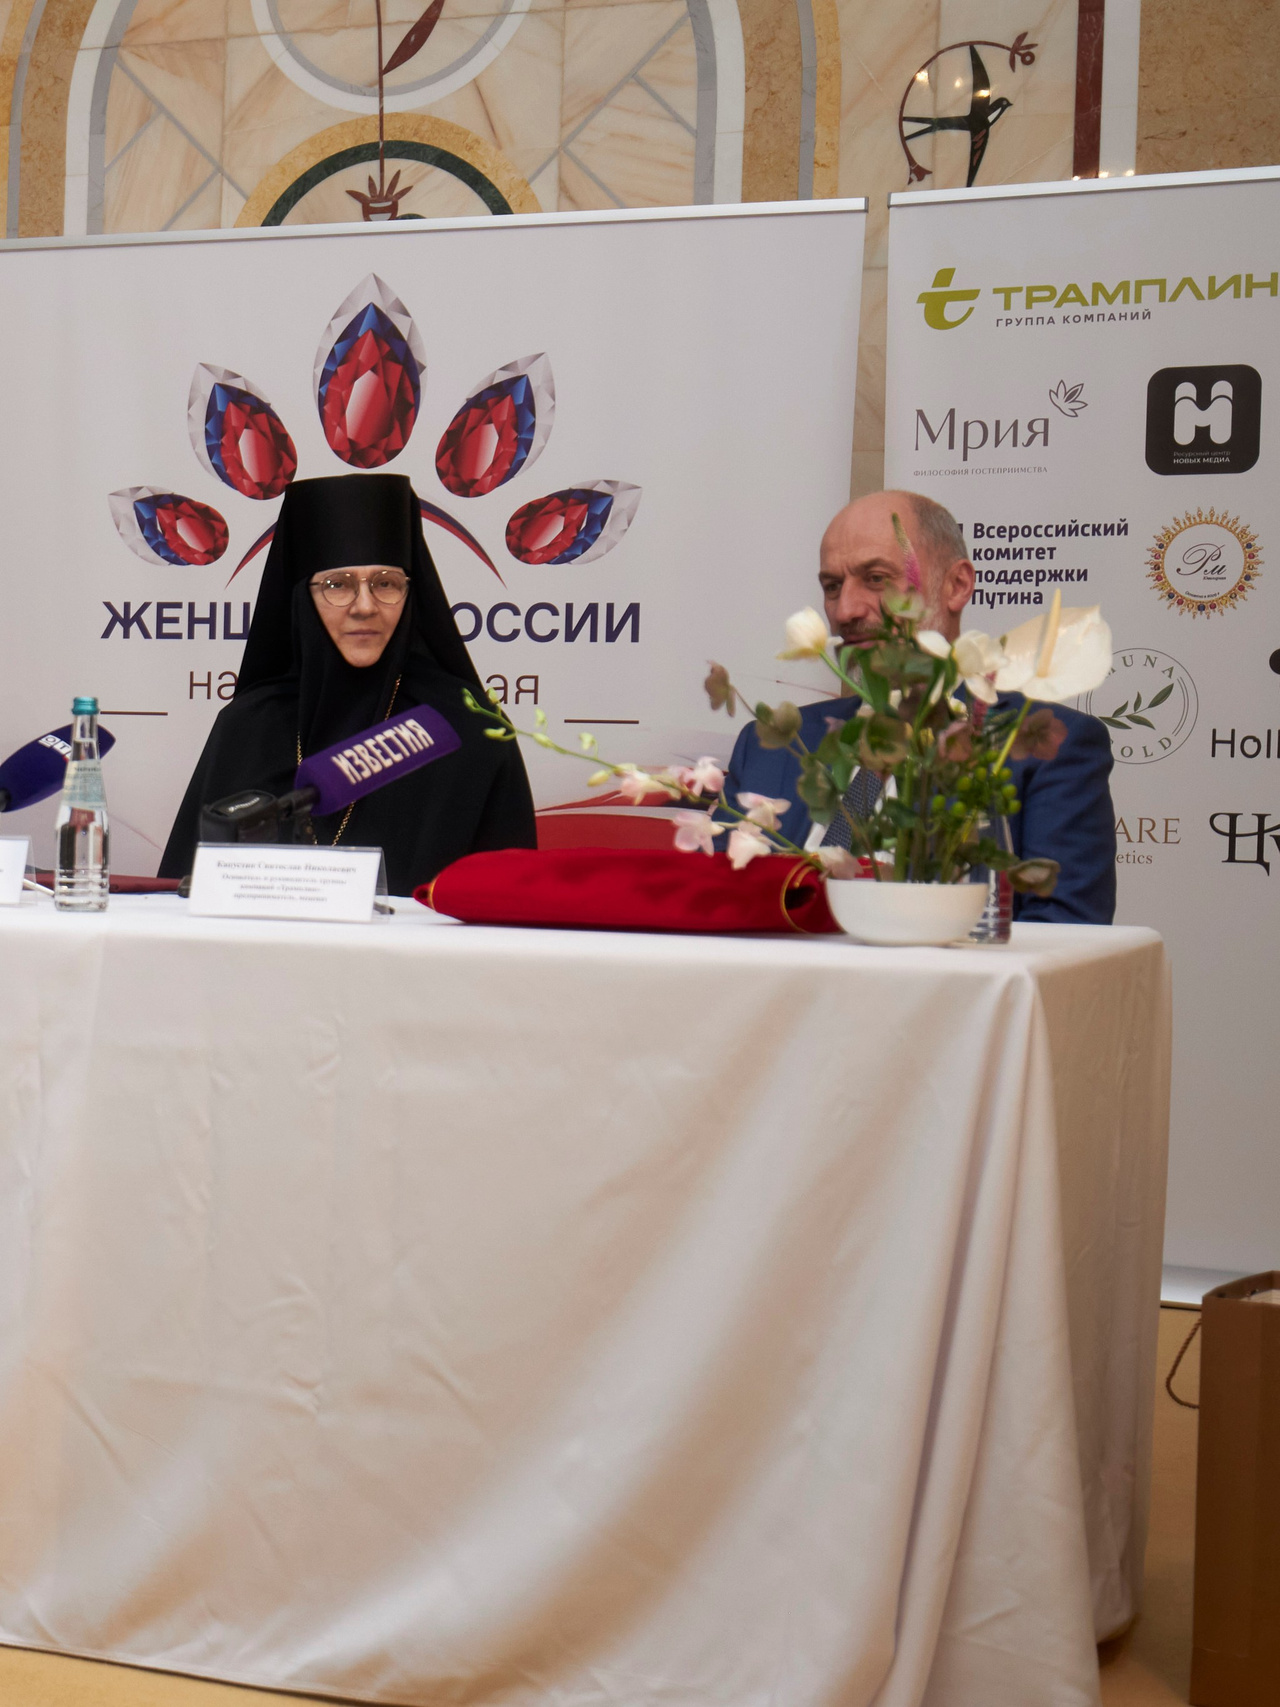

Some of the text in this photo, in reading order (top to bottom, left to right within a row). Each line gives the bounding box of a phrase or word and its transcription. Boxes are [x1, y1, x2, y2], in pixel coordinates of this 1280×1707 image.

[992, 272, 1279, 311] ТРАМПЛИН
[995, 309, 1151, 327] ГРУППА КОМПАНИЙ
[915, 408, 1049, 461] Мрия
[1202, 456, 1231, 464] МЕДИА
[913, 466, 1048, 477] ФИЛОСОФИЯ ГОСТЕПРИИМСТВА
[973, 518, 1129, 543] Всероссийский
[972, 546, 1057, 561] комитет
[974, 568, 1088, 587] поддержки
[971, 589, 1044, 609] Путина
[100, 601, 641, 644] ЖЕНЩ ОССИИ
[331, 718, 435, 785] ИЗВЕСТИЯ
[1114, 817, 1182, 845] ARE
[1116, 850, 1153, 864] etics
